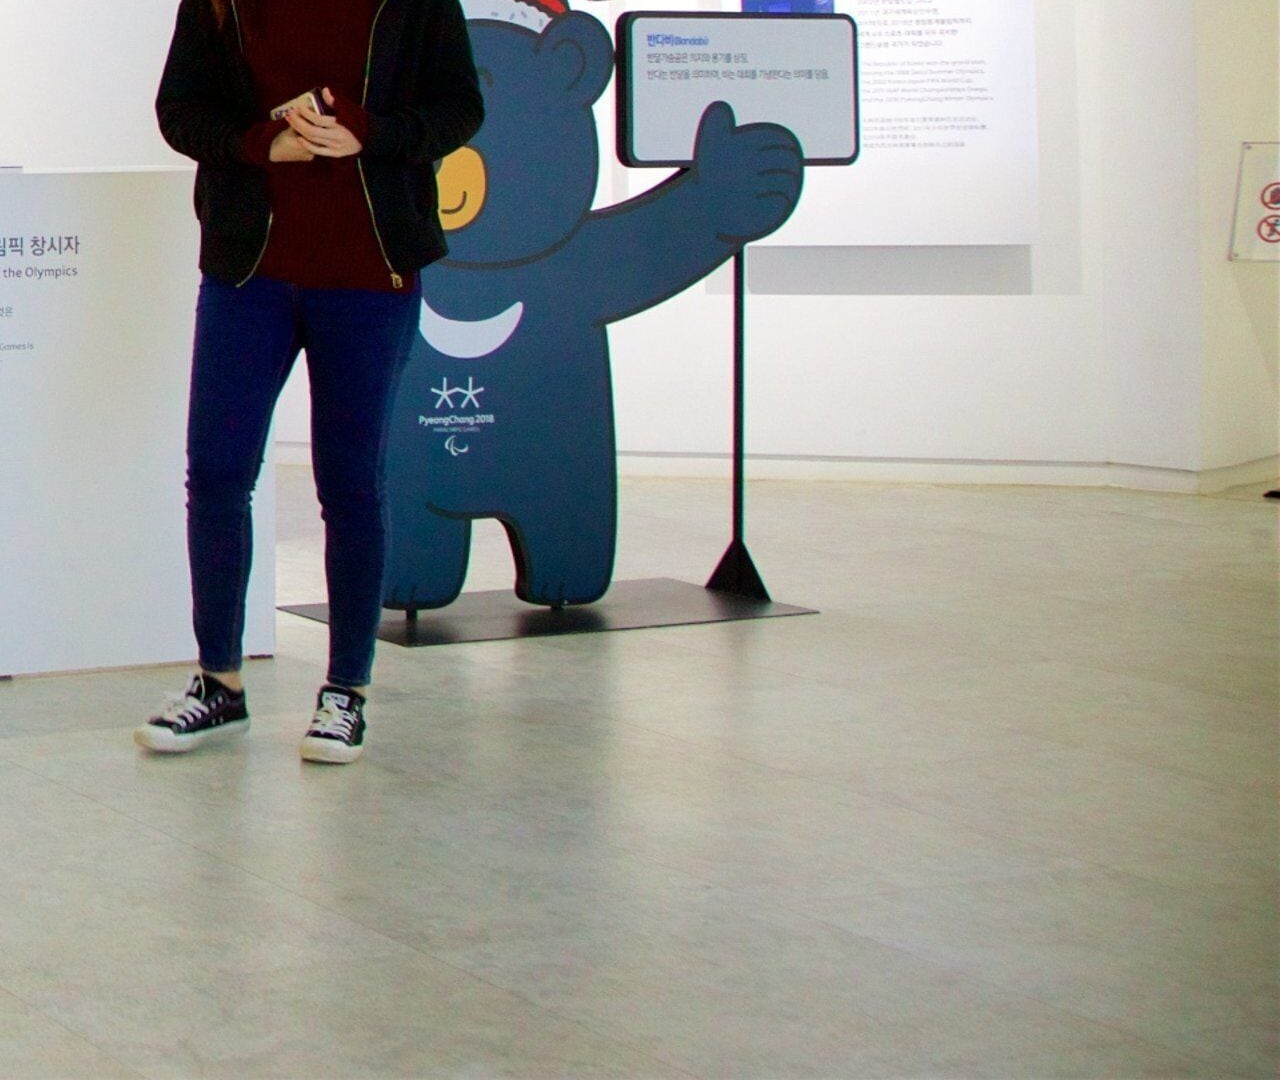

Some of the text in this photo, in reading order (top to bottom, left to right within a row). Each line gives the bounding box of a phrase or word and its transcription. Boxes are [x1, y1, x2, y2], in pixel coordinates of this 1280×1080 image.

[30, 235, 80, 256] 창시자
[2, 266, 22, 279] the
[25, 265, 78, 279] Olympics
[27, 342, 34, 351] is
[419, 414, 495, 426] PyeongChang 2018
